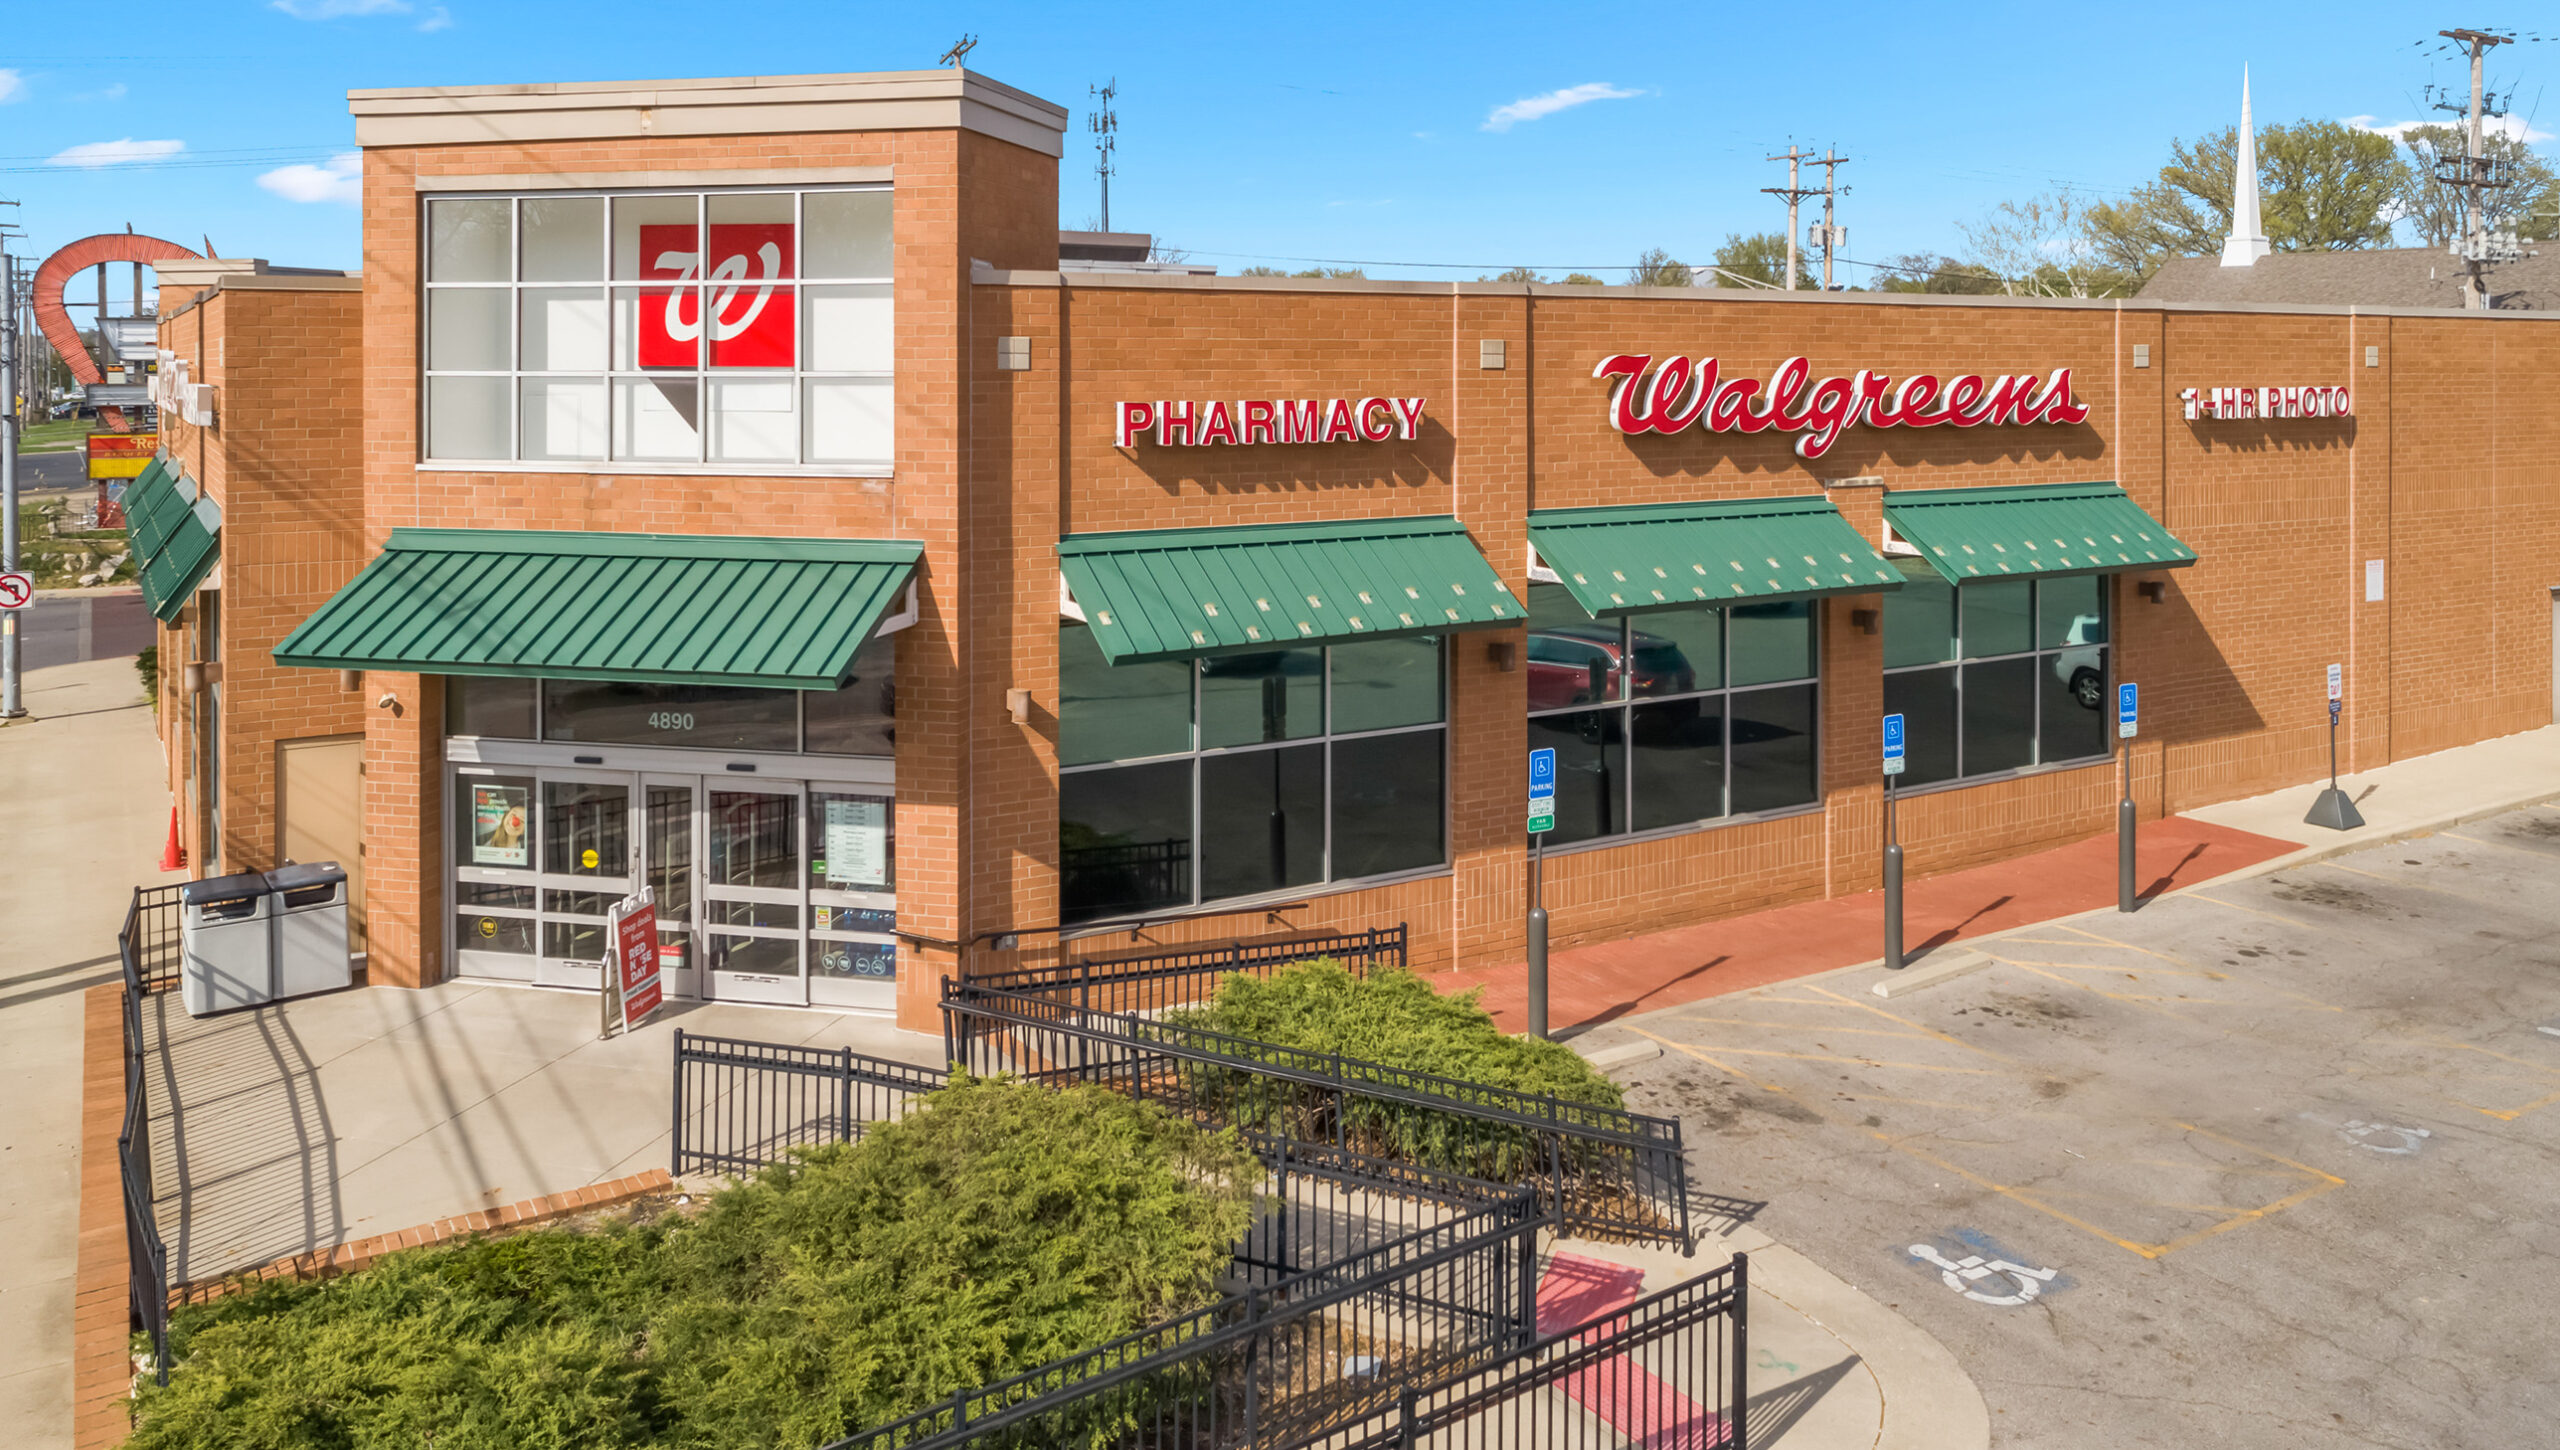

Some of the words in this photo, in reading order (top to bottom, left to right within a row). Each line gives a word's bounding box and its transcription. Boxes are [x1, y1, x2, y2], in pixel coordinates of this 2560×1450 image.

[1592, 354, 2090, 459] Walgreens
[2181, 387, 2256, 420] 1-HR
[2258, 386, 2351, 418] PHOTO
[1114, 396, 1426, 448] PHARMACY
[648, 711, 694, 730] 4890
[1531, 782, 1553, 792] PARKING
[622, 922, 637, 936] Shop
[637, 913, 652, 927] deals
[631, 930, 645, 943] from
[628, 942, 646, 960] RED
[629, 949, 653, 971] NSE
[630, 964, 648, 983] DAY
